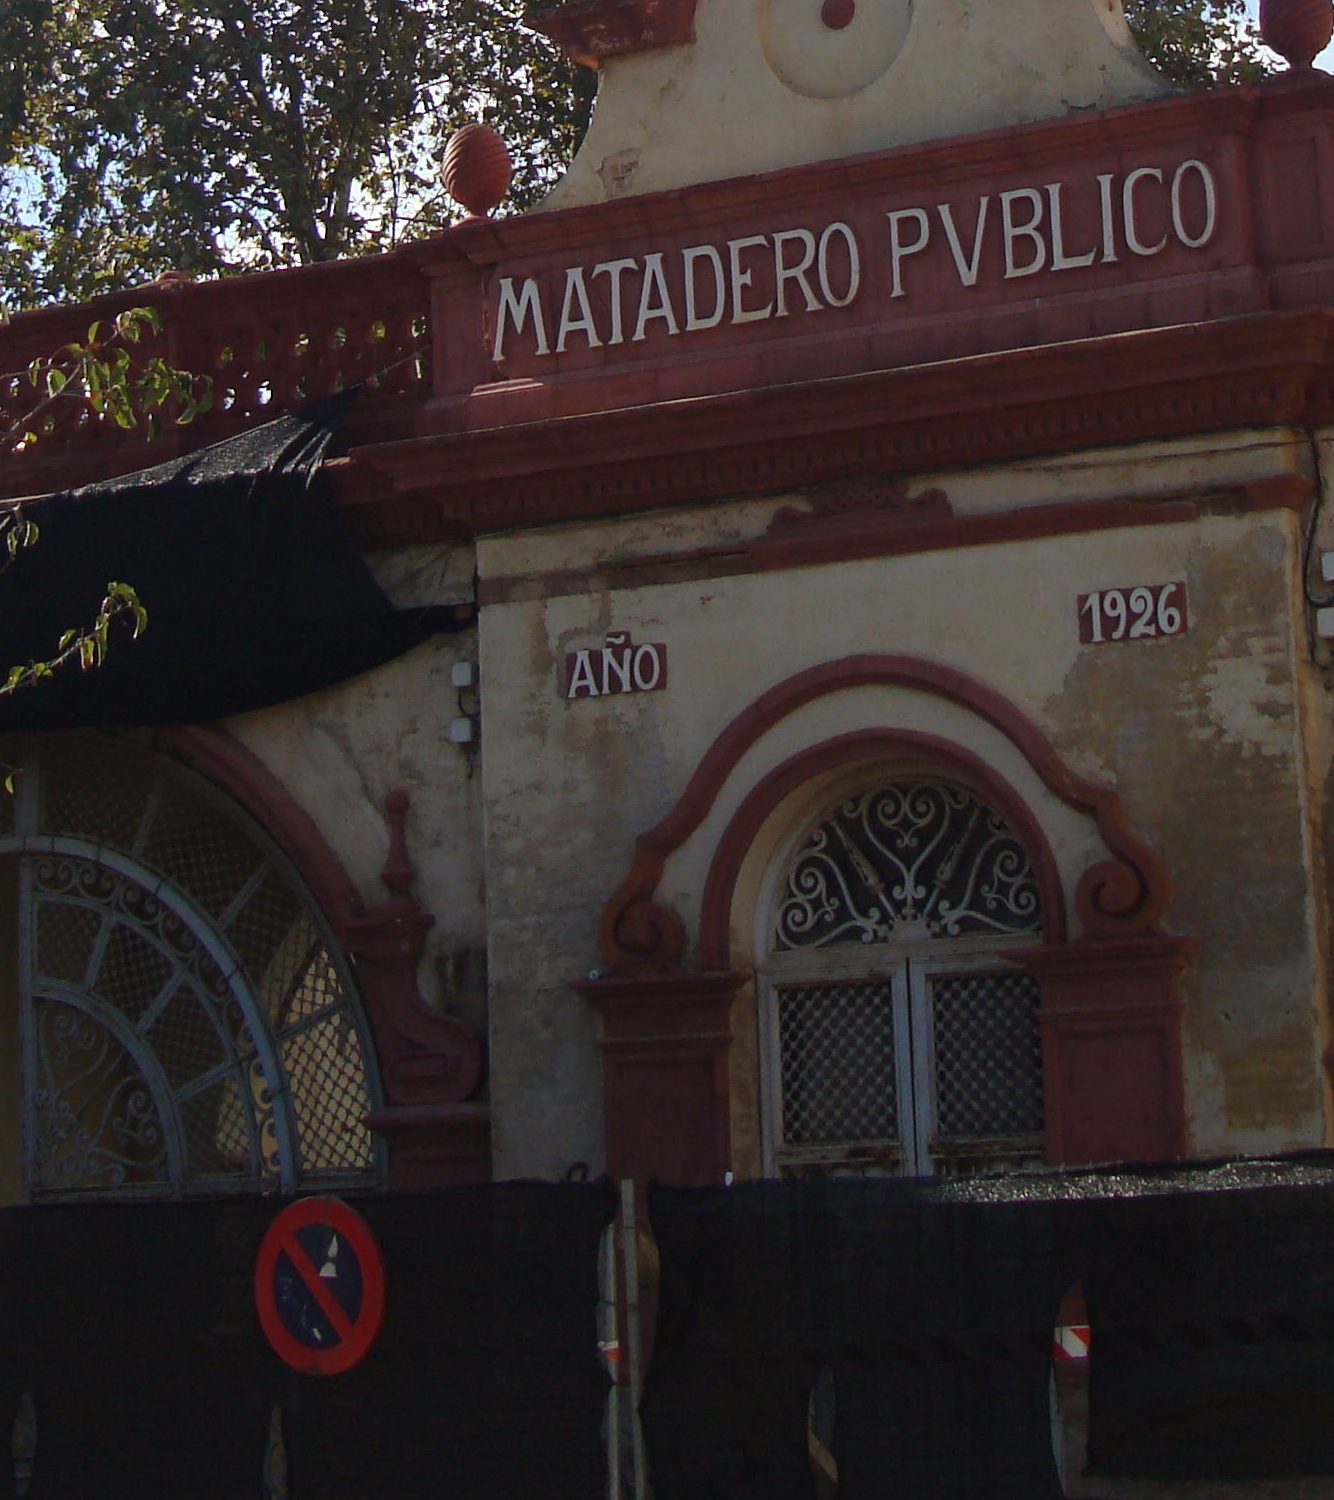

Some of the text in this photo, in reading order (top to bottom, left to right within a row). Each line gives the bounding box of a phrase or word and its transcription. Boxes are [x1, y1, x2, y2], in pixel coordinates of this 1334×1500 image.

[491, 158, 1216, 361] MATADERO PVBLICO
[1080, 583, 1181, 642] 1926
[568, 636, 660, 698] AÑO
